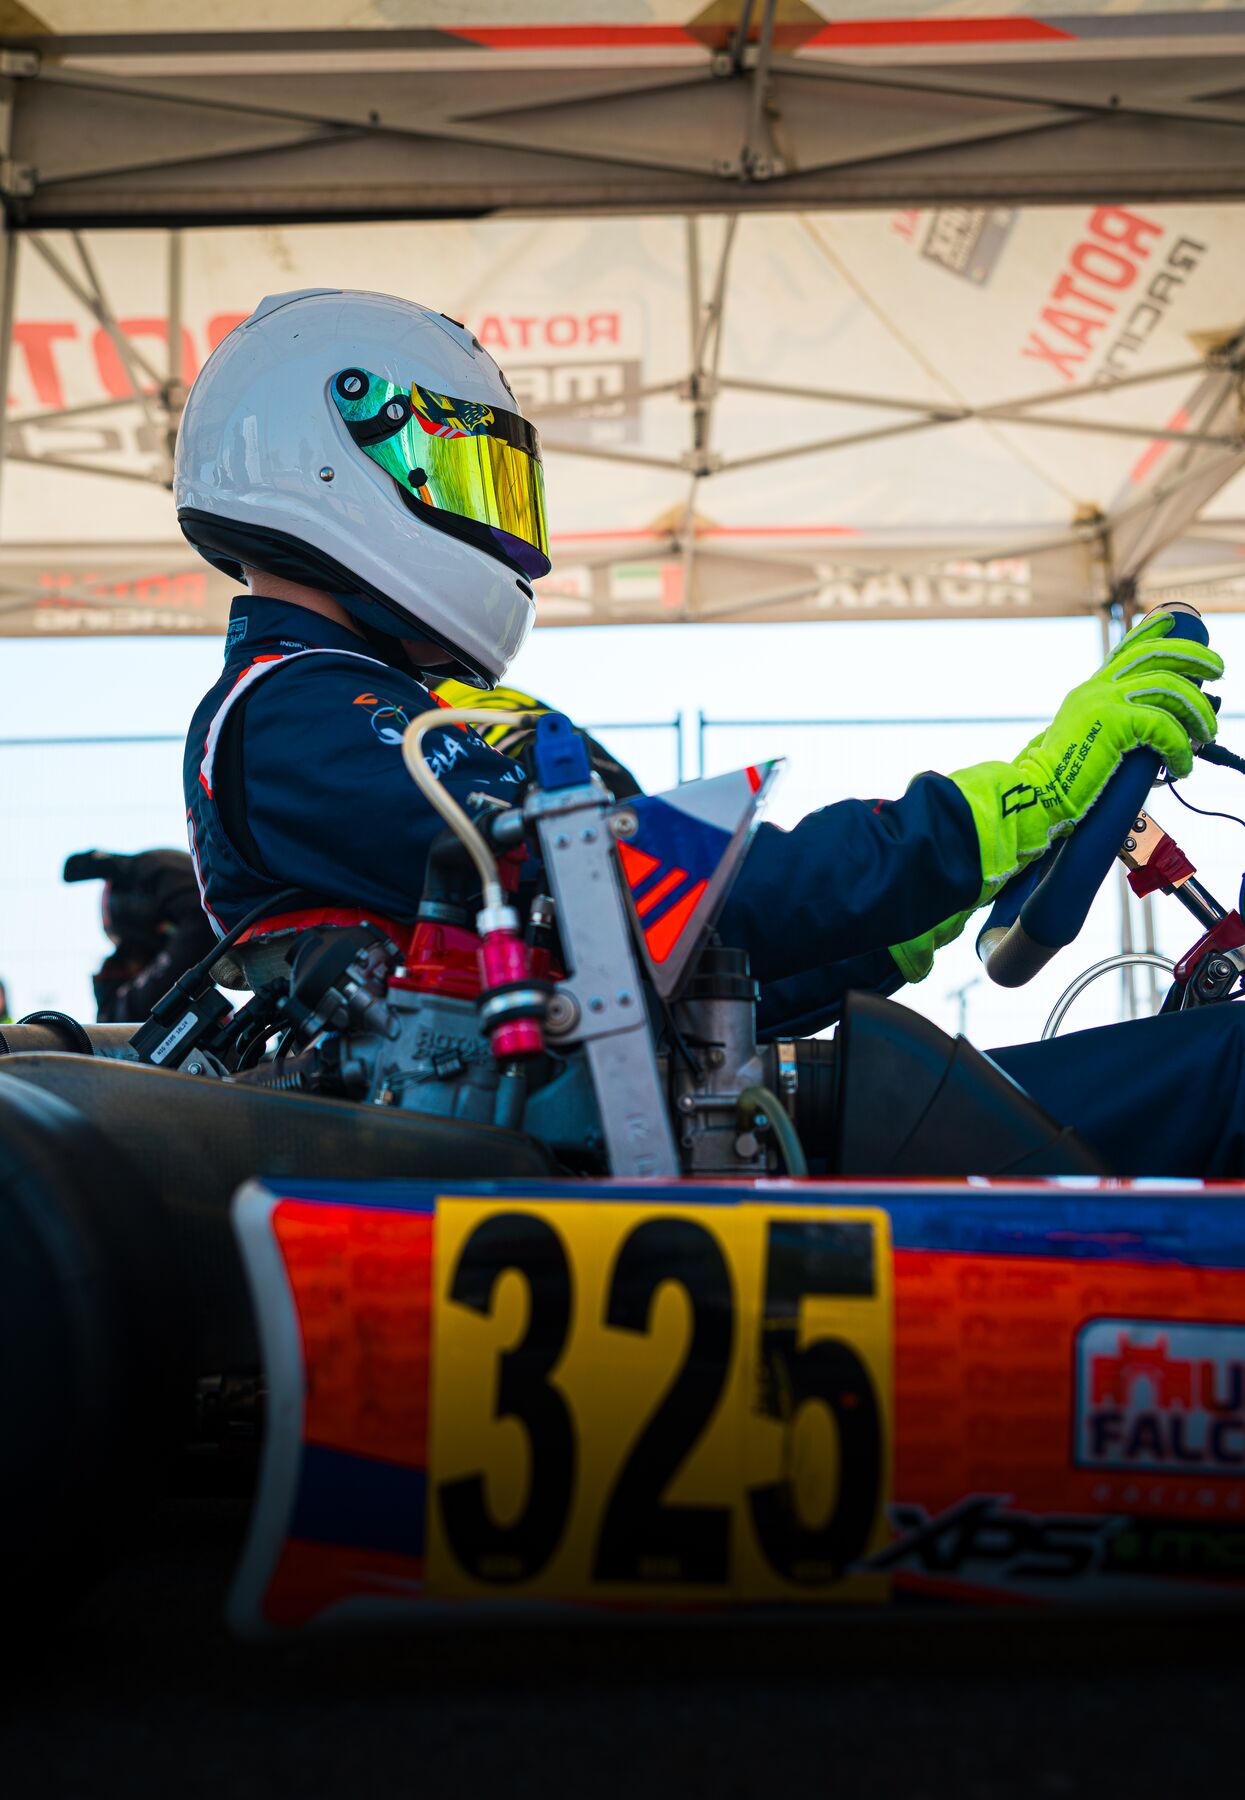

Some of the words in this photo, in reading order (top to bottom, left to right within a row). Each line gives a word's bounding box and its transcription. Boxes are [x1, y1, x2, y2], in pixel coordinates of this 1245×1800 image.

[1065, 759, 1083, 785] RACE
[1076, 740, 1092, 762] USE
[1085, 719, 1104, 744] ONLY
[440, 1212, 884, 1587] 325
[1090, 1411, 1245, 1463] FALC
[850, 1494, 1128, 1578] XPS
